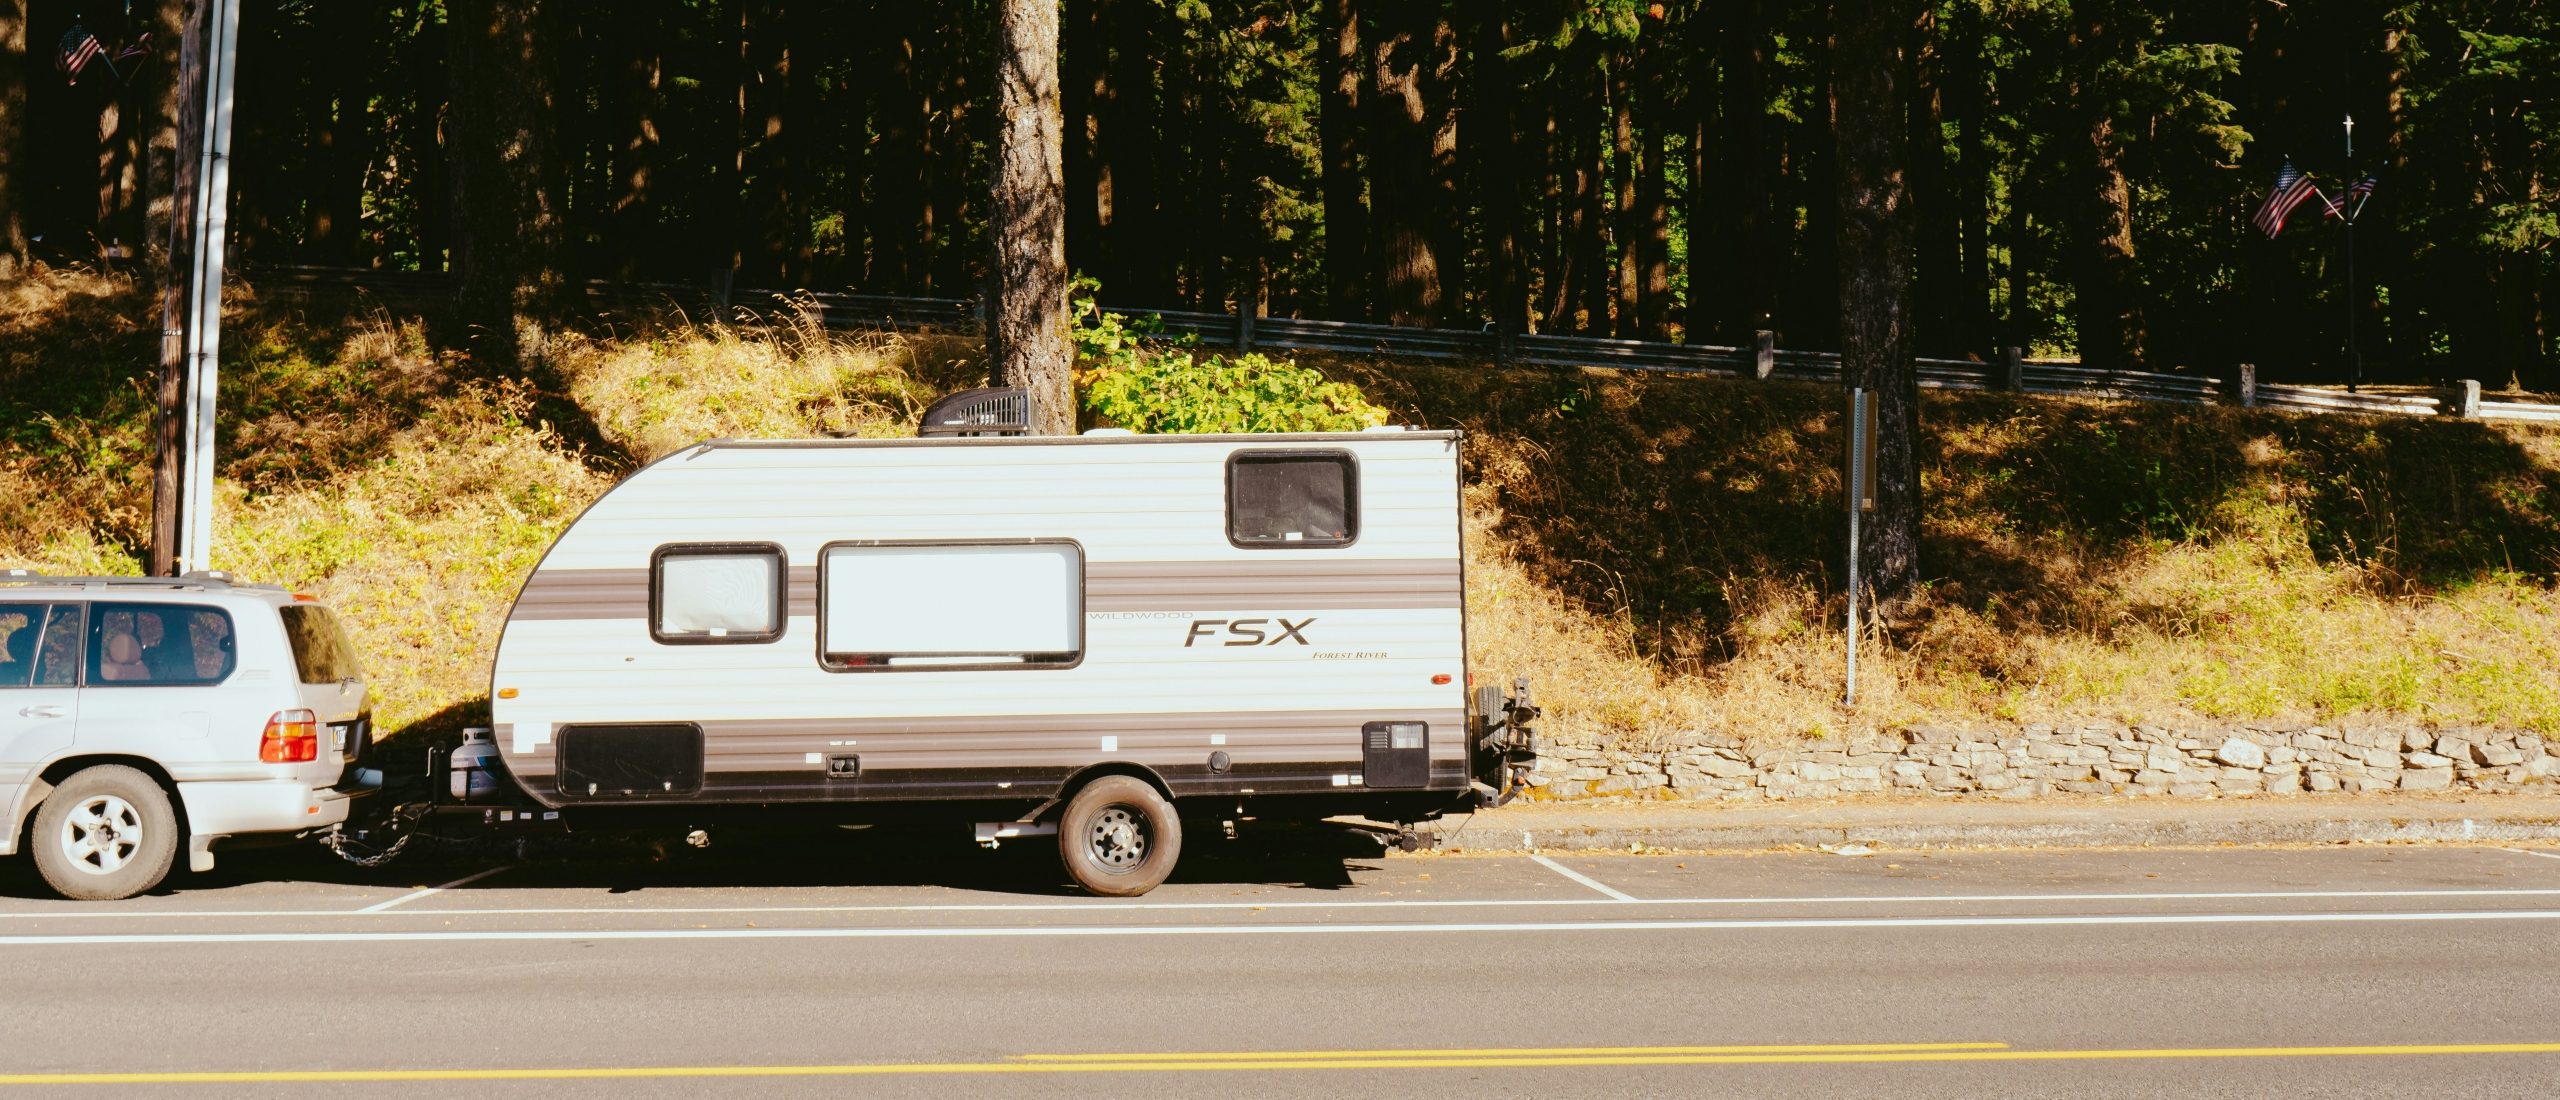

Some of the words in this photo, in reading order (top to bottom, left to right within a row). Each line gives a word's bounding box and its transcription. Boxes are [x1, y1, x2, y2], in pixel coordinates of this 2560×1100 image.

[1089, 612, 1194, 620] WILDWOOD
[1183, 617, 1319, 647] FSX
[1312, 651, 1353, 659] FOREST
[1355, 651, 1388, 659] RIVER
